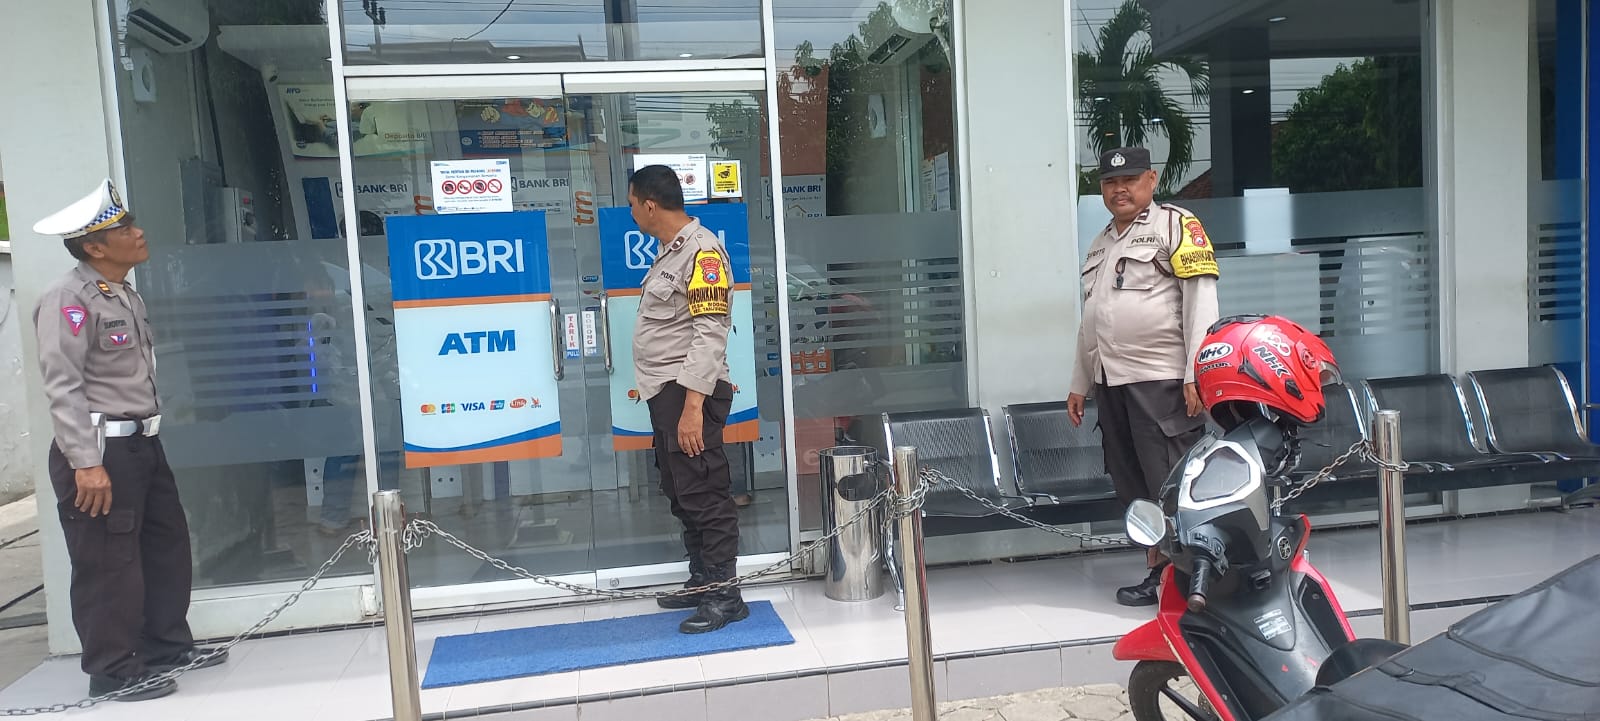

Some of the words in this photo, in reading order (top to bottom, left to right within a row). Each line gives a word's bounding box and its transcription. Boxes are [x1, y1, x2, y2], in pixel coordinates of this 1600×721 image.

[389, 183, 408, 193] BRI
[519, 179, 550, 189] BANK
[552, 177, 569, 187] BRI
[1131, 236, 1156, 245] POLRI
[459, 239, 525, 275] BRI
[567, 315, 576, 348] TARIK
[438, 330, 516, 356] ATM
[1199, 345, 1228, 362] NHK
[1253, 346, 1290, 378] NHK
[460, 401, 485, 411] VISA
